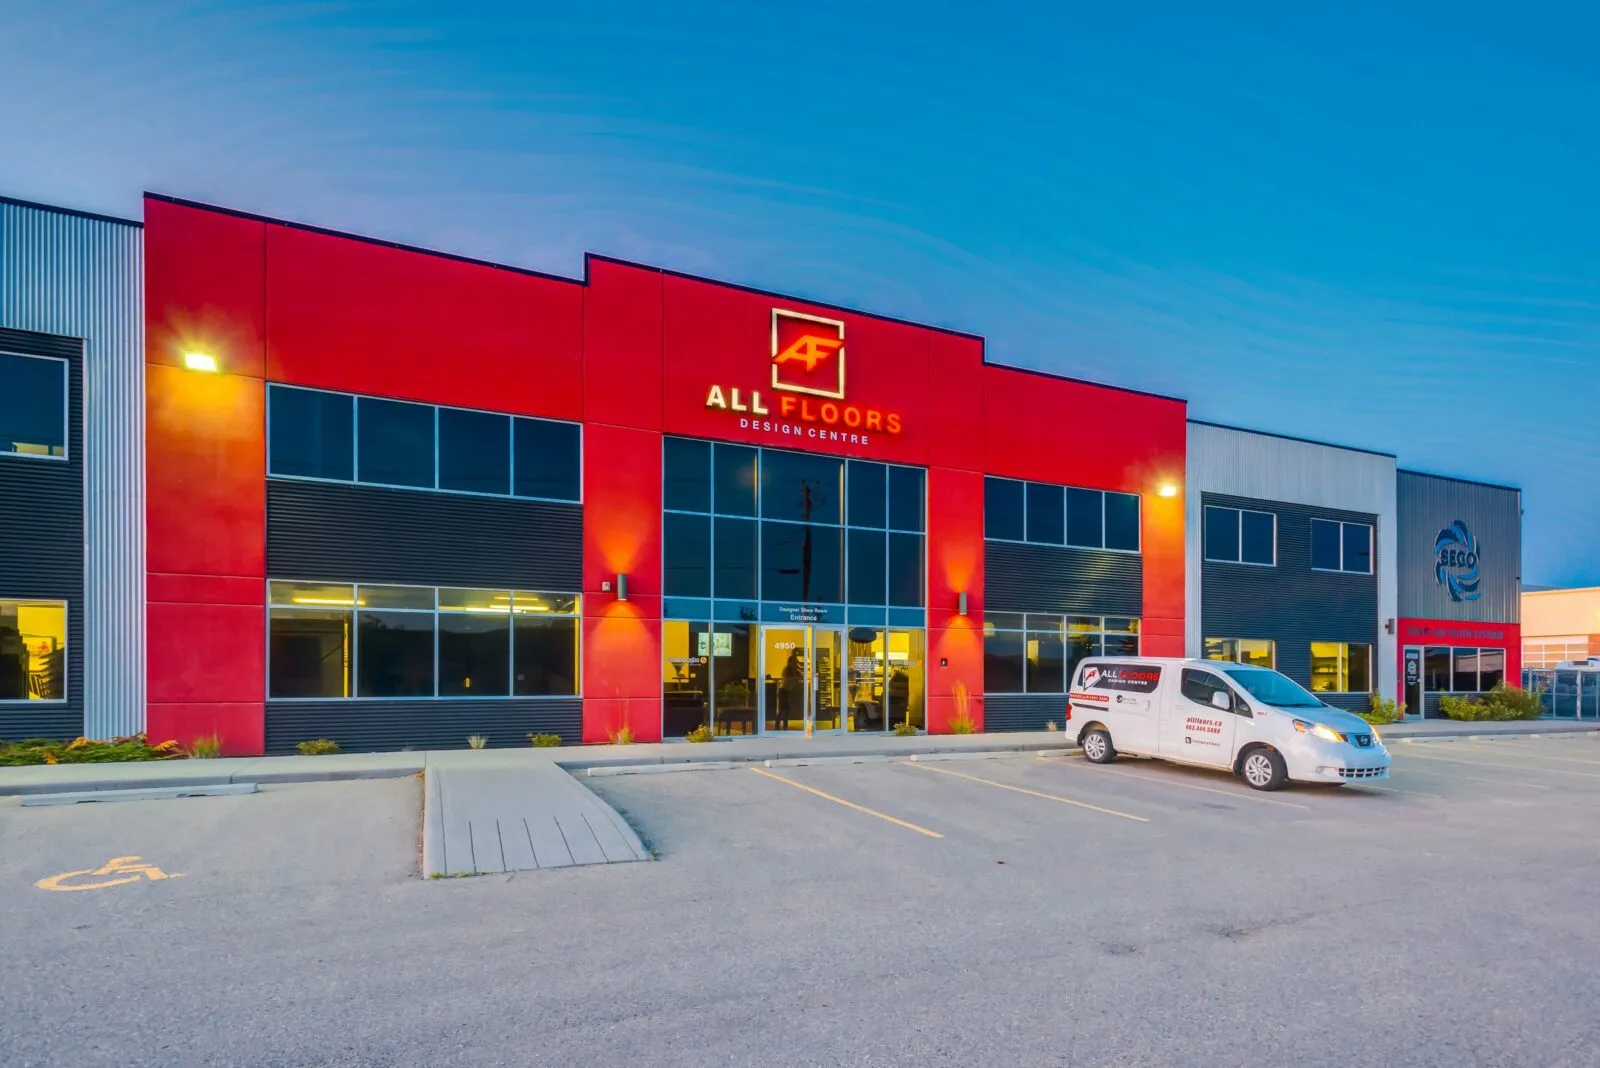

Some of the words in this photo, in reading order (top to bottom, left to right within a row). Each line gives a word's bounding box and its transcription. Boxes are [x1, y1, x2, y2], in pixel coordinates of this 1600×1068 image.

[705, 385, 769, 415] ALL
[780, 396, 902, 434] FLOORS
[740, 418, 802, 436] DESIGN
[808, 429, 869, 445] CENTRE
[790, 613, 818, 621] Entrance
[774, 641, 796, 650] 4950
[1101, 669, 1118, 679] ALL
